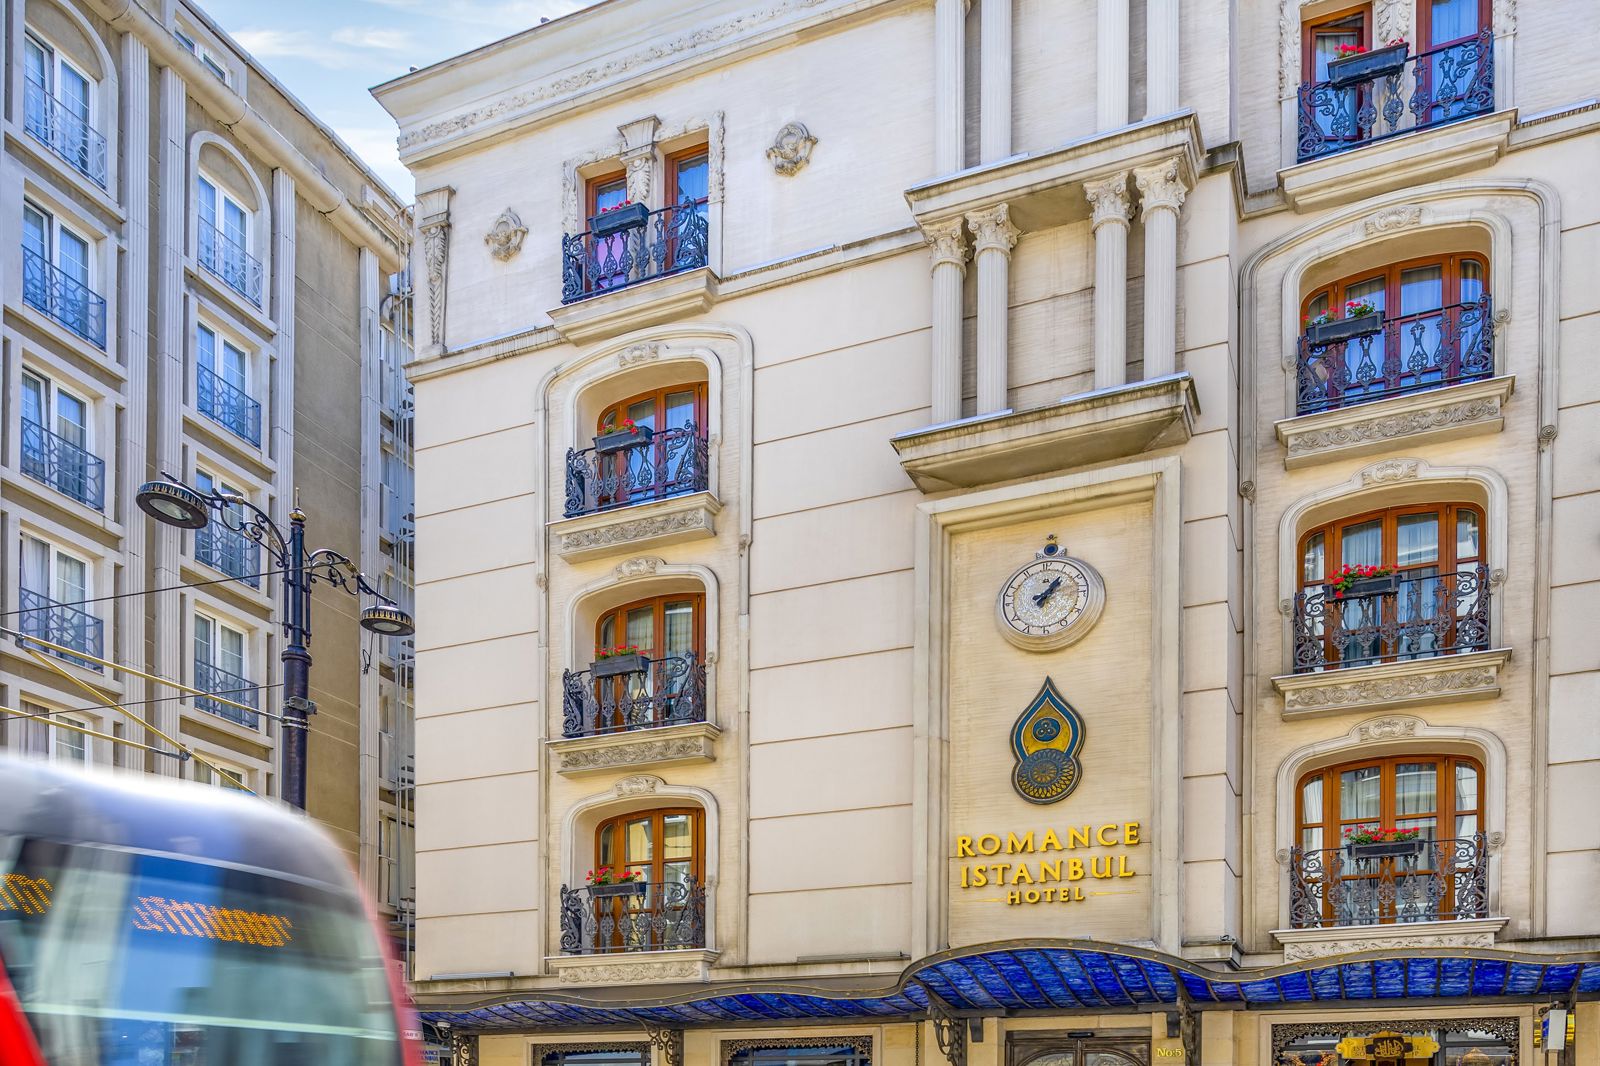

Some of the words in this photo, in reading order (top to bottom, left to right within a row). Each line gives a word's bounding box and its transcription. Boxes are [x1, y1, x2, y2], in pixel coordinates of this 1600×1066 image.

[957, 822, 1140, 858] ROMANCE
[961, 855, 1136, 888] ISTANBUL
[1007, 886, 1086, 905] HOTEL
[1156, 1047, 1182, 1057] No:5
